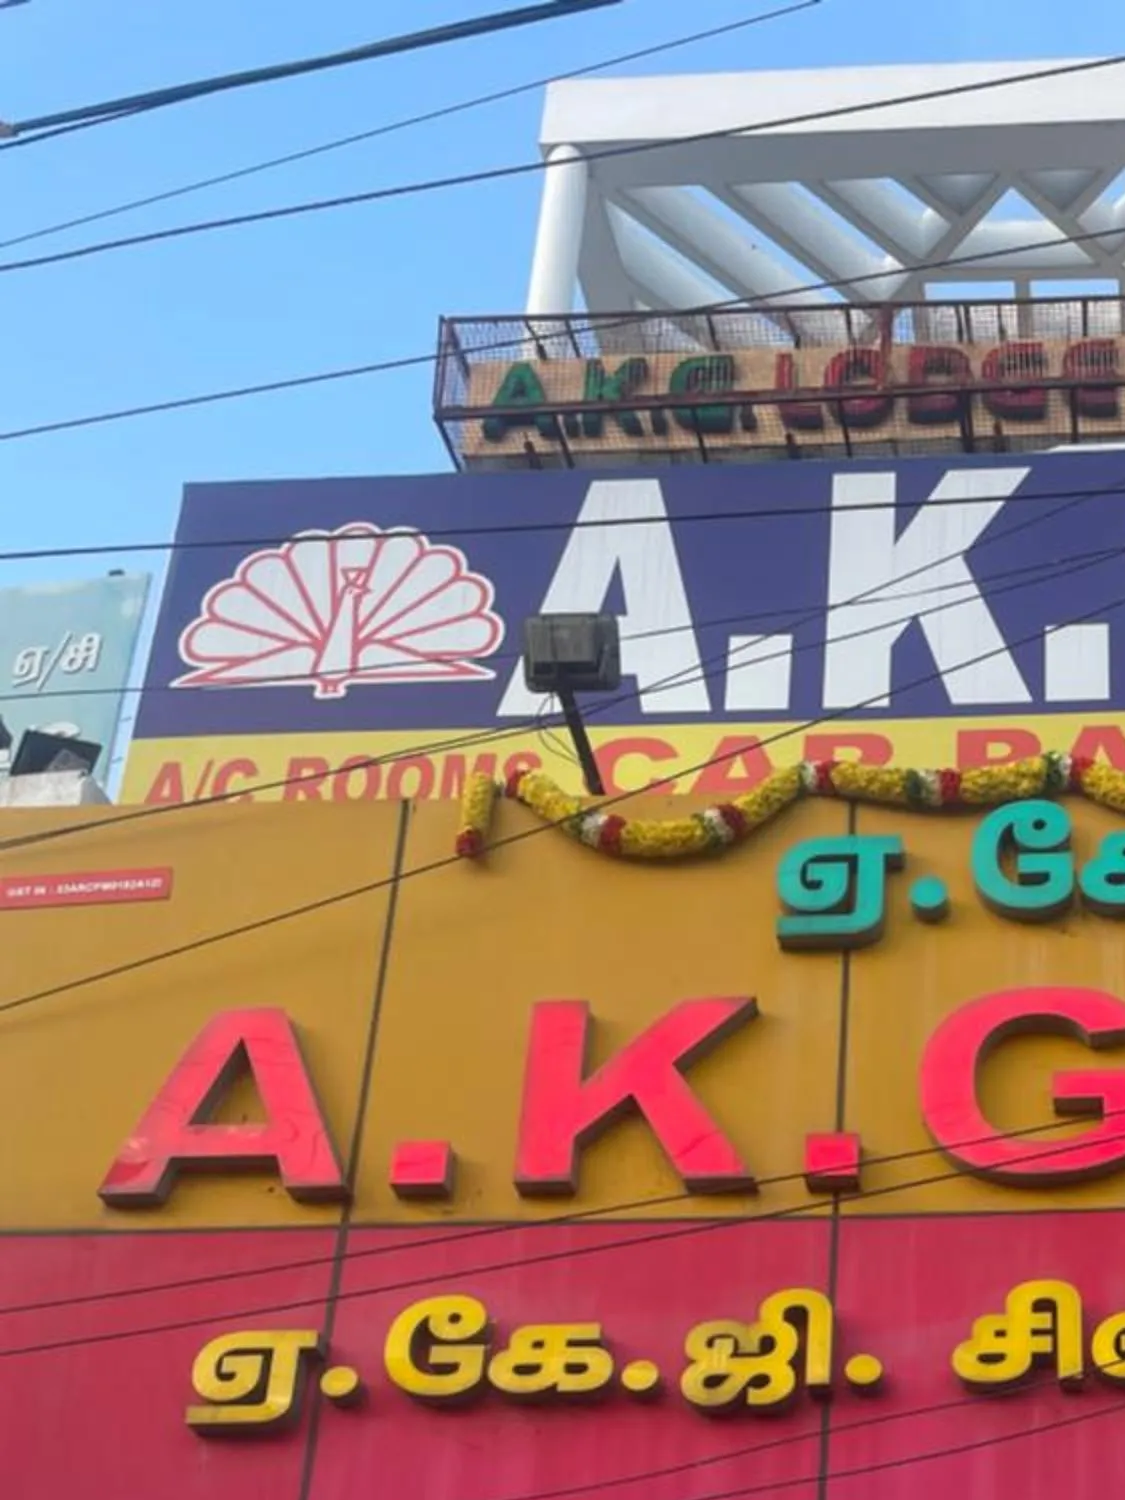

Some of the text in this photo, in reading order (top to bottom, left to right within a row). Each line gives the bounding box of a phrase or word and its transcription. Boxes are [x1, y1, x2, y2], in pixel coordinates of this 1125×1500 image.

[776, 338, 1120, 429] LODGE
[146, 758, 258, 804] A/C
[185, 1287, 884, 1434] ஏ.கே.ஜி.
